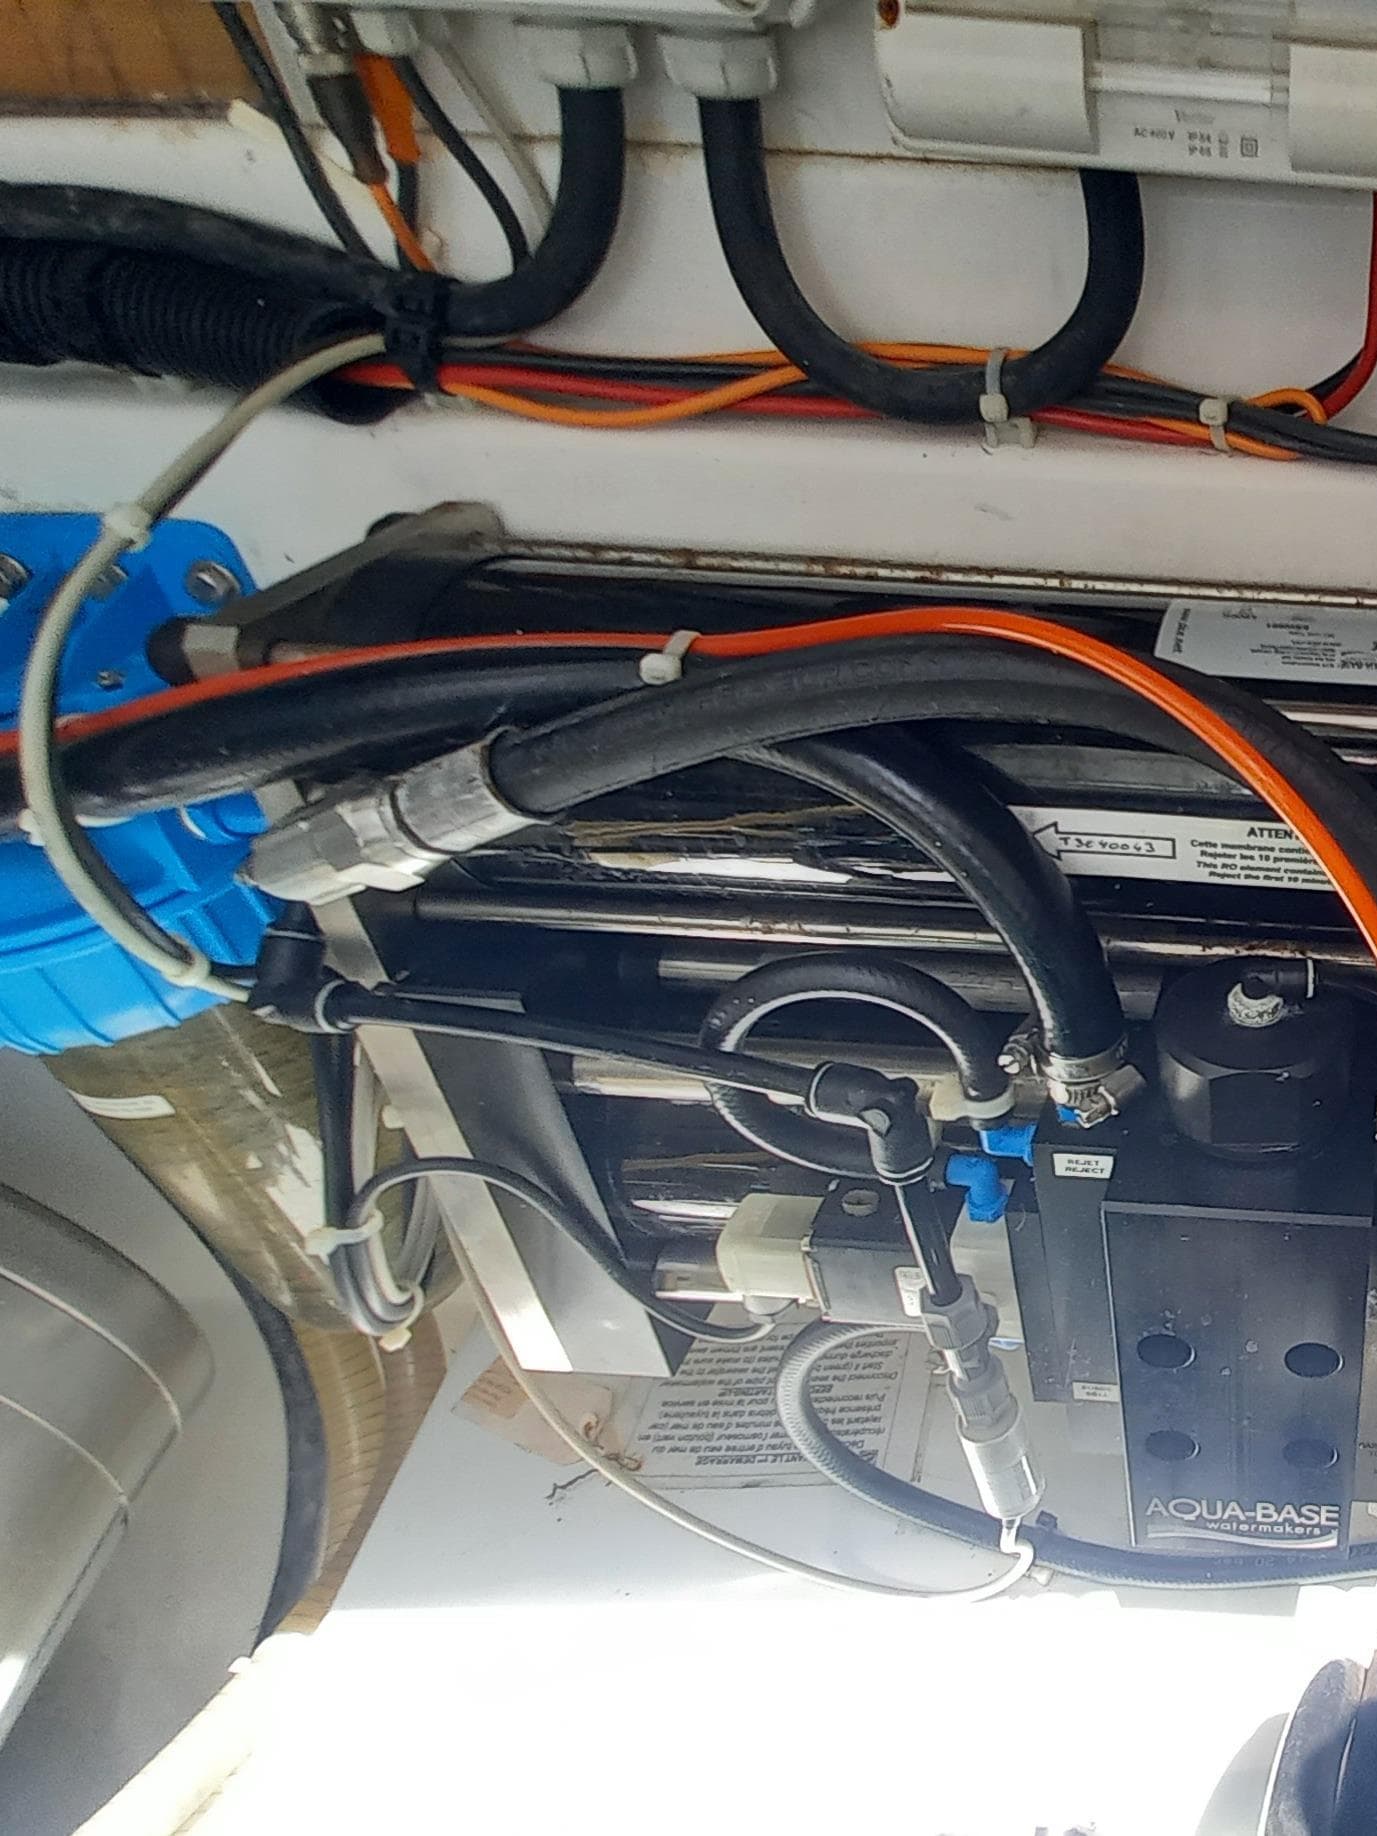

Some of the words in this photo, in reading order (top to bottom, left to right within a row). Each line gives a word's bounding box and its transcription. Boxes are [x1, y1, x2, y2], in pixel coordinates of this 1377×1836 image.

[1064, 1166, 1105, 1174] REJECT
[1145, 1496, 1340, 1527] AQUA-BASE
[1206, 1520, 1321, 1537] watermakers
